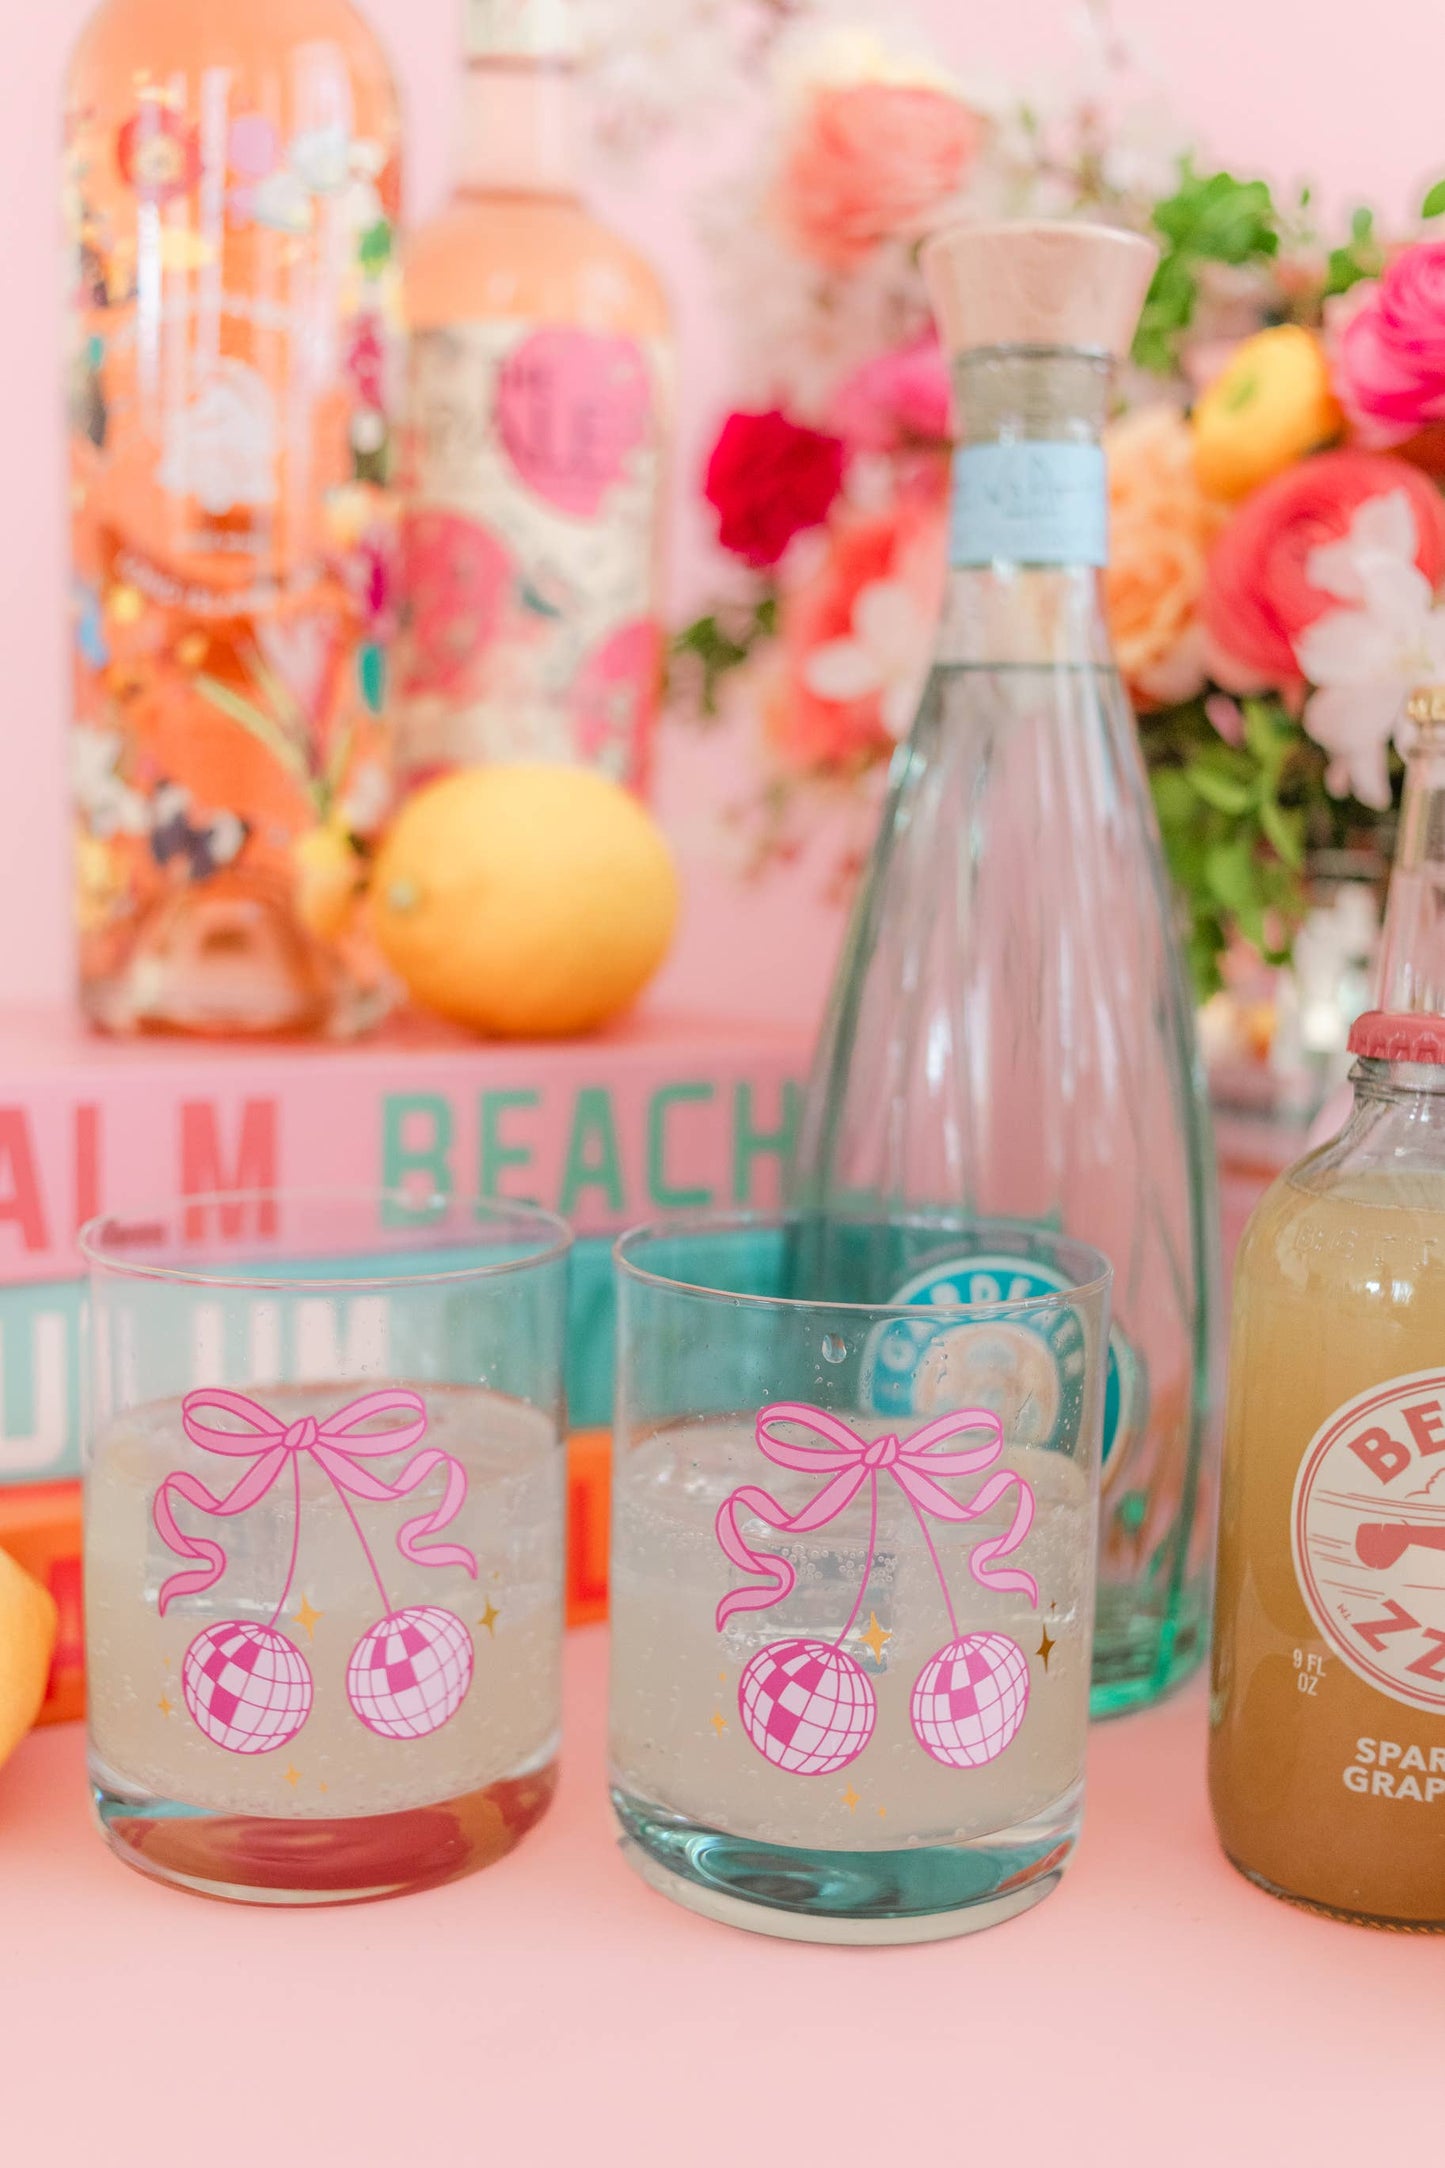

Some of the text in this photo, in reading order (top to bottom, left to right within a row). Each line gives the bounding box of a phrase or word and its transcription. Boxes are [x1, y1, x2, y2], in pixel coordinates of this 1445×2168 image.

[378, 1082, 799, 1228] BEACH
[1346, 1400, 1445, 1486] BE
[1293, 1648, 1327, 1678] 9 FL
[1297, 1671, 1319, 1697] OZ
[1354, 1736, 1445, 1783] SPAR
[1342, 1765, 1445, 1804] GRAP
